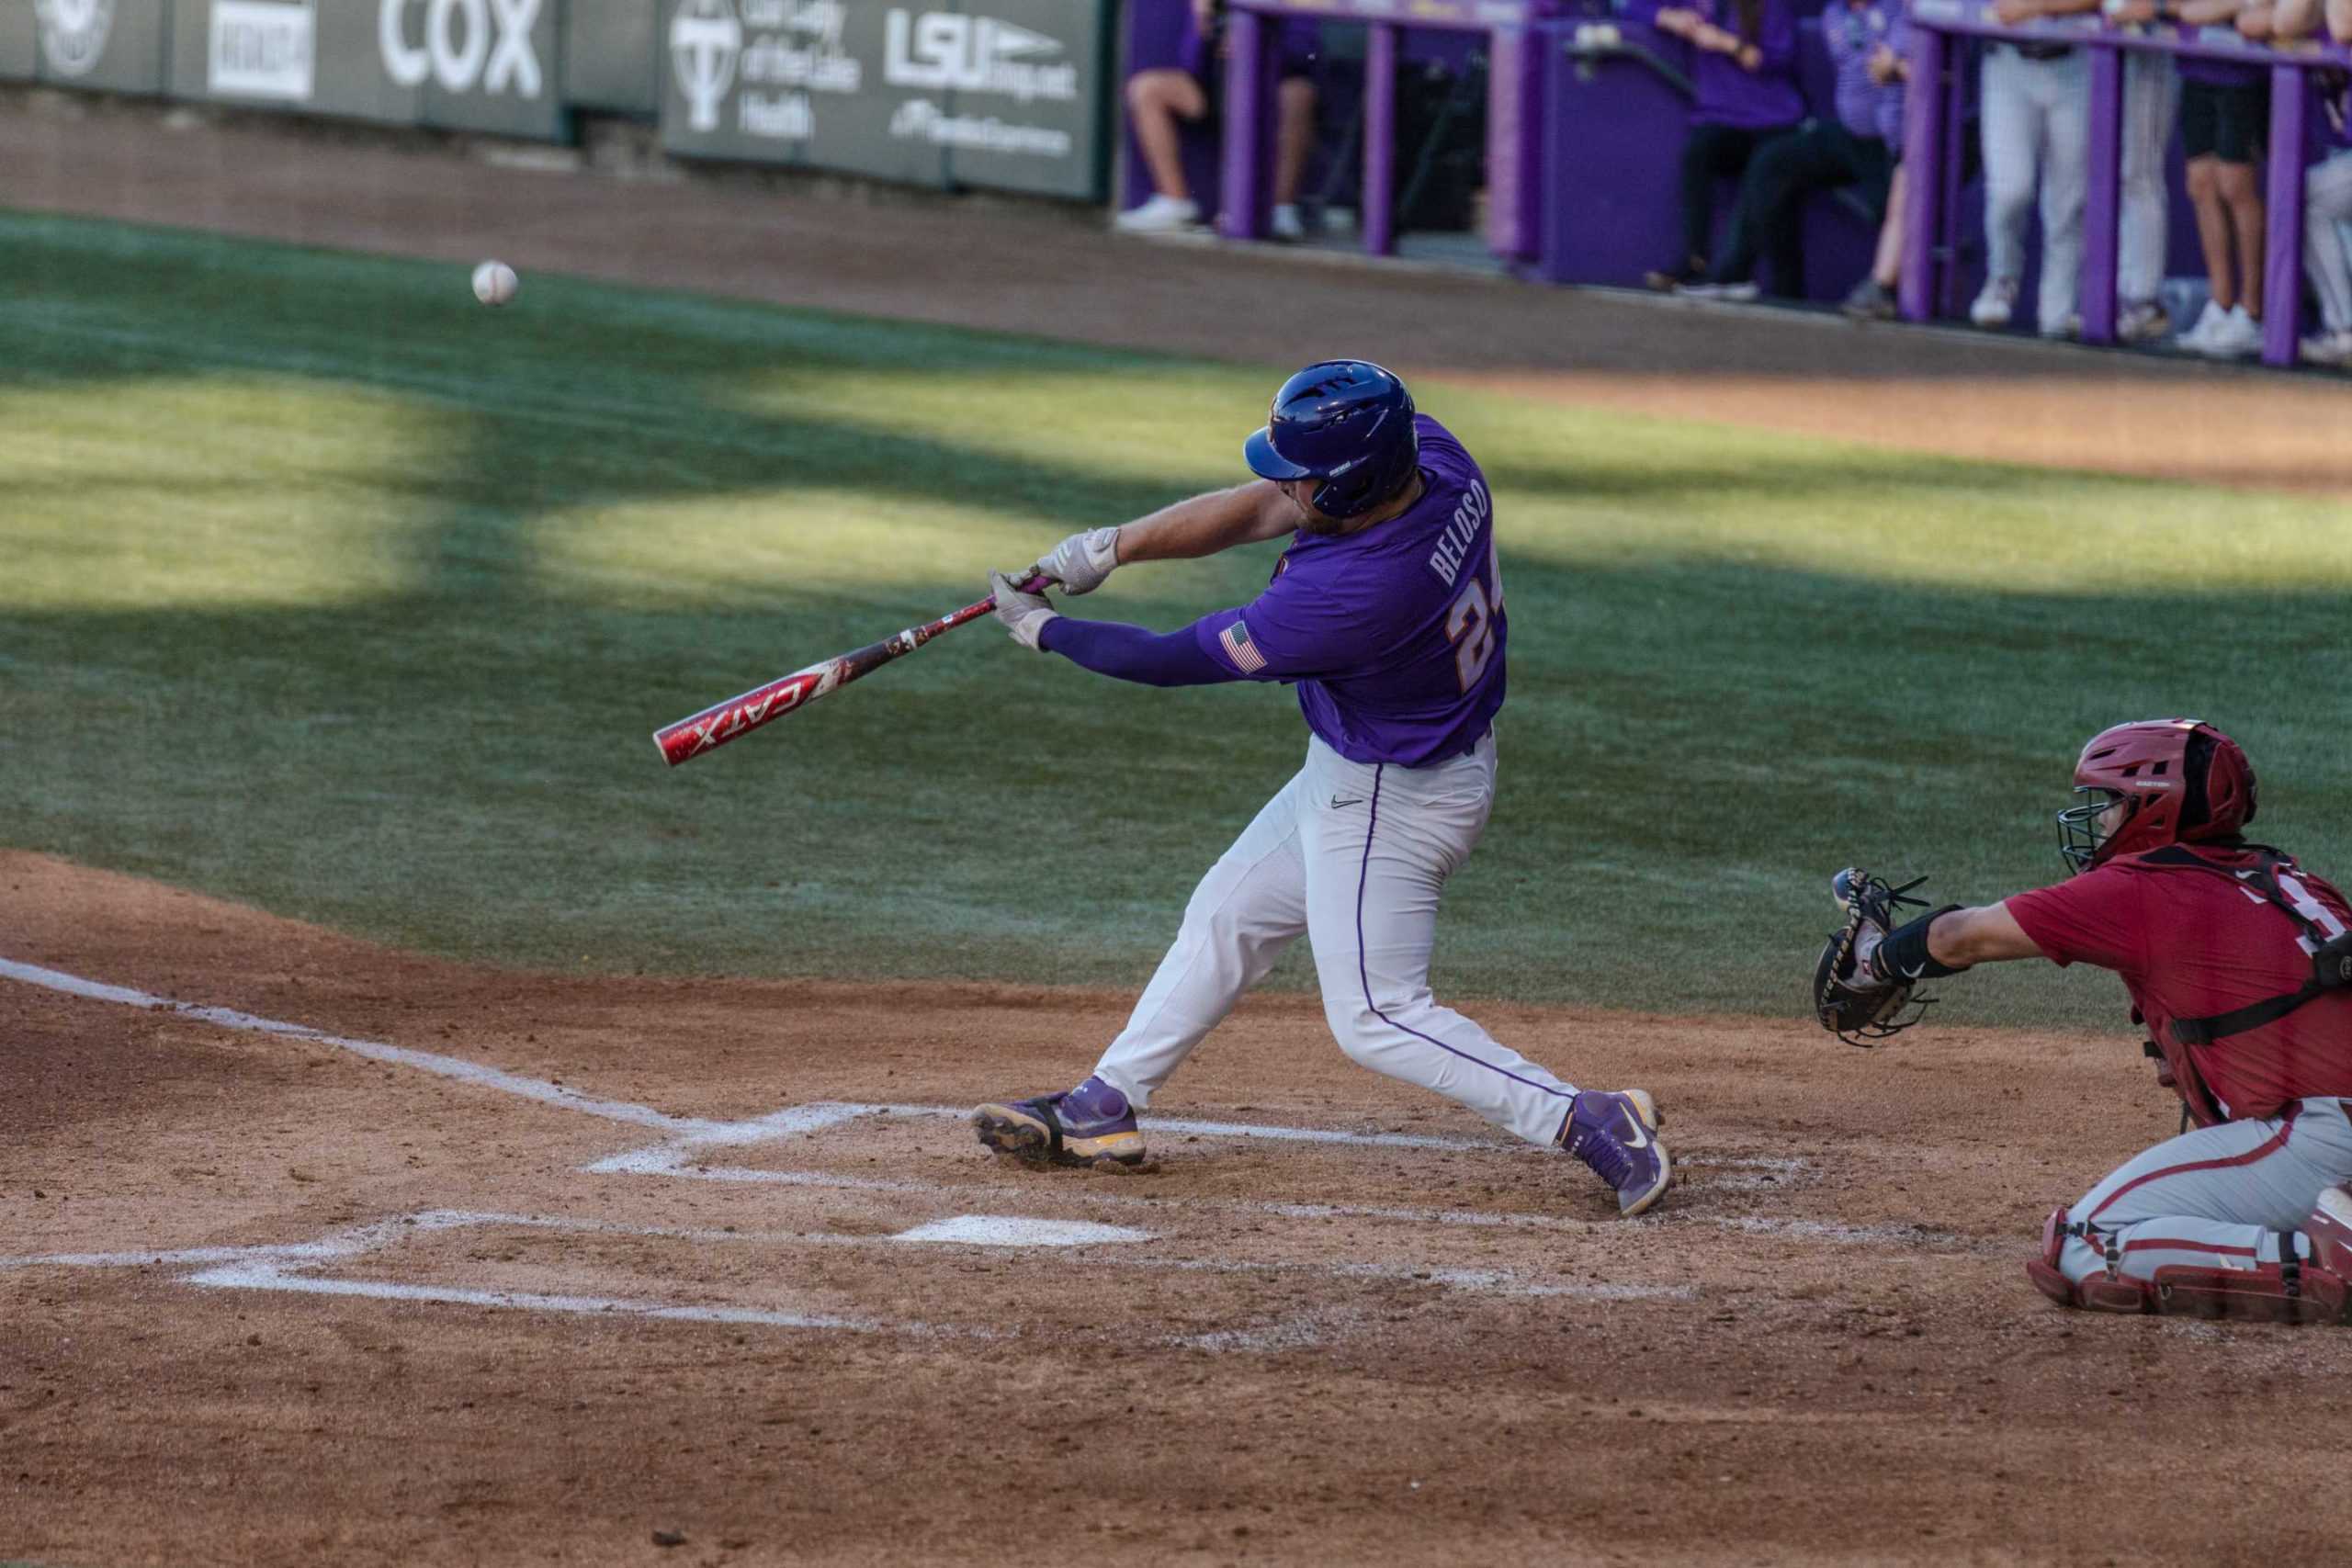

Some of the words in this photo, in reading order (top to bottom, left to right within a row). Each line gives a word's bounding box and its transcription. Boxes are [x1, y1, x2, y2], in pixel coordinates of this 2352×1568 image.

[378, 0, 542, 98] COX
[885, 8, 995, 90] LSU
[1430, 479, 1487, 587] BELOSO
[691, 682, 801, 754] CATX
